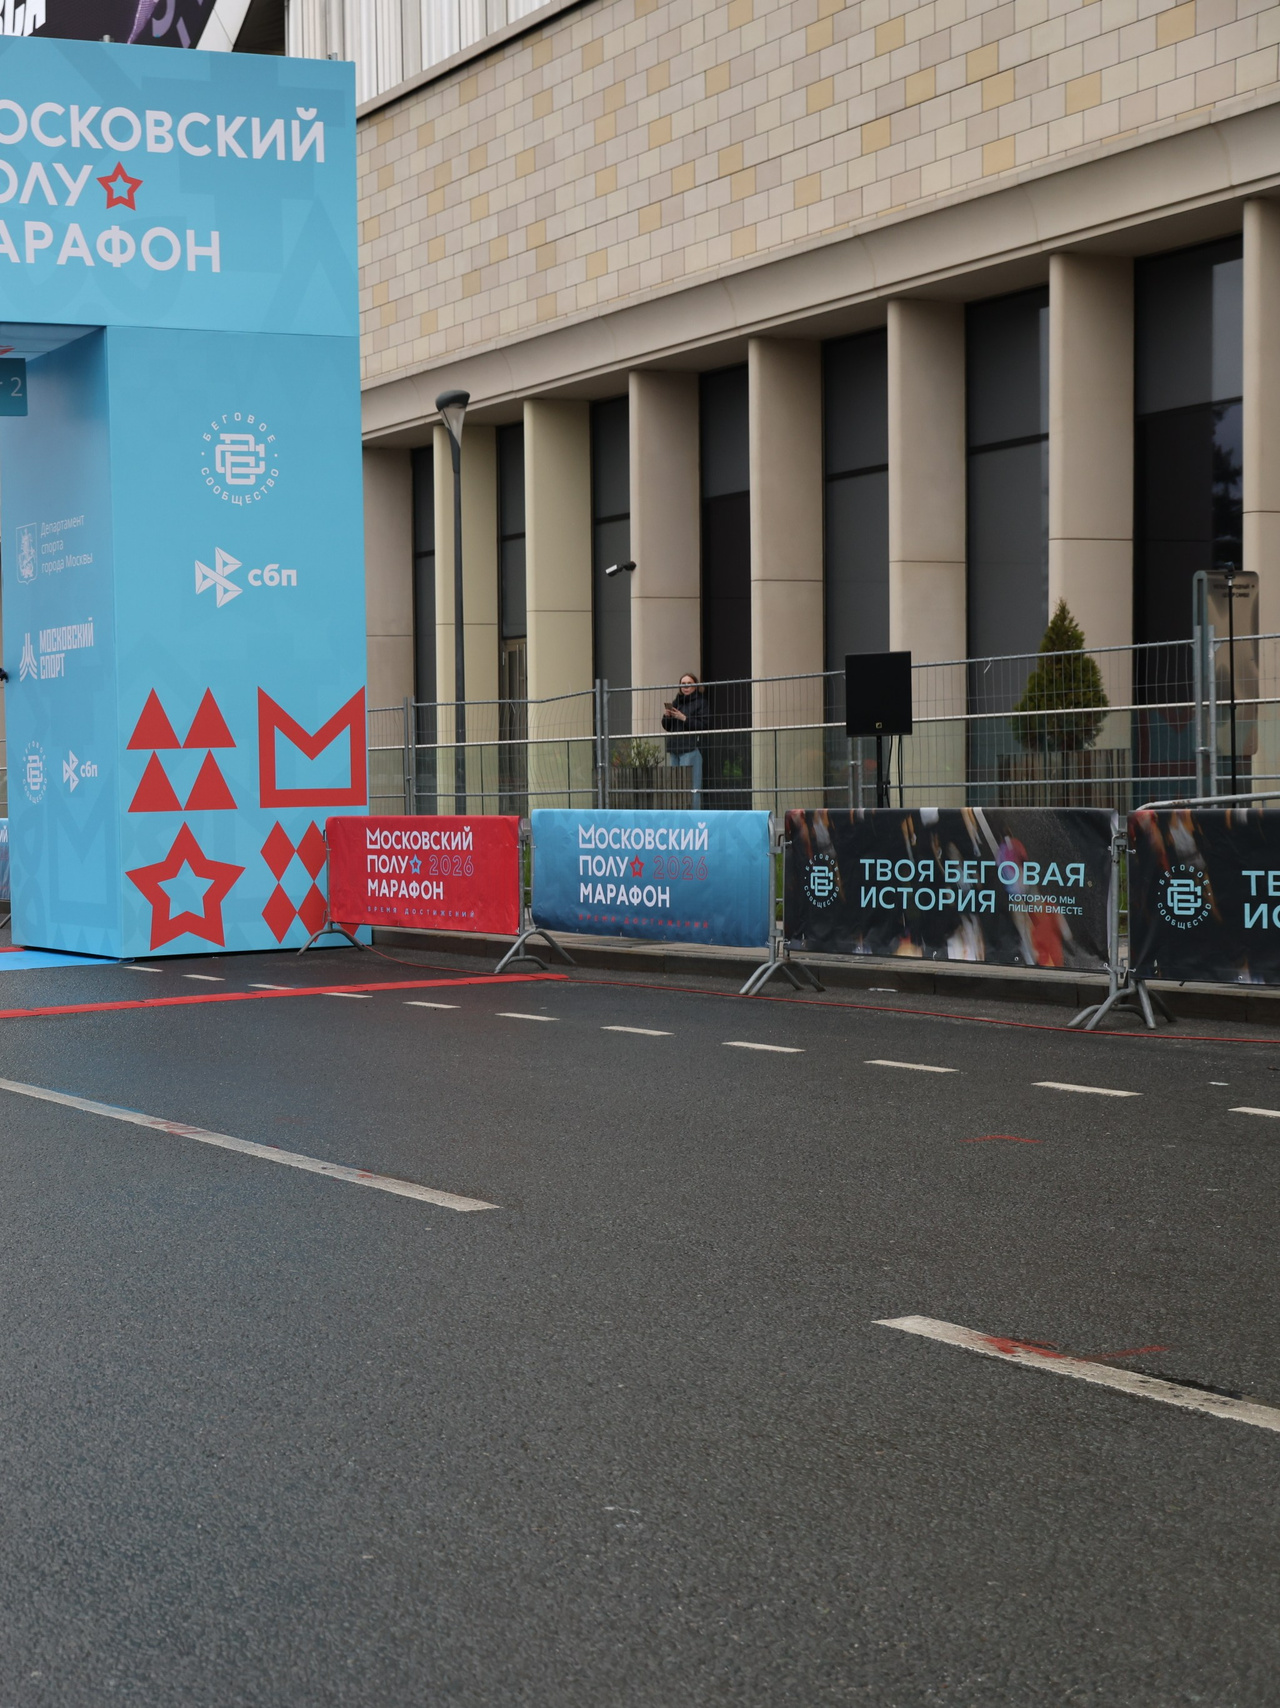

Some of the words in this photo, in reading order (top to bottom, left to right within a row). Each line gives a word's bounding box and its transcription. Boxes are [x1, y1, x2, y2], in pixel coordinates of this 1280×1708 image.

[10, 377, 22, 398] 2
[202, 411, 276, 443] БЕГОВОЕ
[201, 466, 280, 506] СООБЩЕСТВО
[41, 514, 85, 538] Департамент
[41, 538, 64, 554] спорта
[41, 558, 65, 574] города
[66, 552, 94, 568] Москвы
[248, 563, 298, 587] сбп
[39, 617, 94, 654] МОСКОВСКИЙ
[40, 653, 65, 679] СПОРТ
[80, 761, 98, 778] сбп
[365, 826, 473, 851] МОСКОВСКИЙ
[578, 822, 709, 851] МОСКОВСКИЙ
[367, 854, 409, 874] ПОЛУ
[429, 855, 473, 876] 2026
[579, 855, 629, 877] ПОЛУ
[653, 855, 708, 880] 2026
[805, 853, 839, 873] БЕГОВОЕ
[860, 858, 934, 883] ТВОЯ
[944, 860, 1085, 887] БЕГОВАЯ
[1159, 864, 1210, 886] БЕГОВОЕ
[367, 879, 444, 900] МАРАФОН
[580, 883, 670, 908] МАРАФОН
[804, 885, 840, 909] СООБЩЕСТВО
[860, 886, 996, 913] ИСТОРИЯ
[1008, 893, 1057, 904] КОТОРУЮ
[1059, 896, 1076, 905] МЫ
[368, 906, 397, 914] ВРЕМЯ
[404, 908, 475, 918] ДОСТИЖЕНИЙ
[1008, 904, 1043, 913] ПИШЕМ
[1045, 905, 1083, 915] ВМЕСТЕ
[1157, 902, 1212, 930] СООБЩЕСТВО
